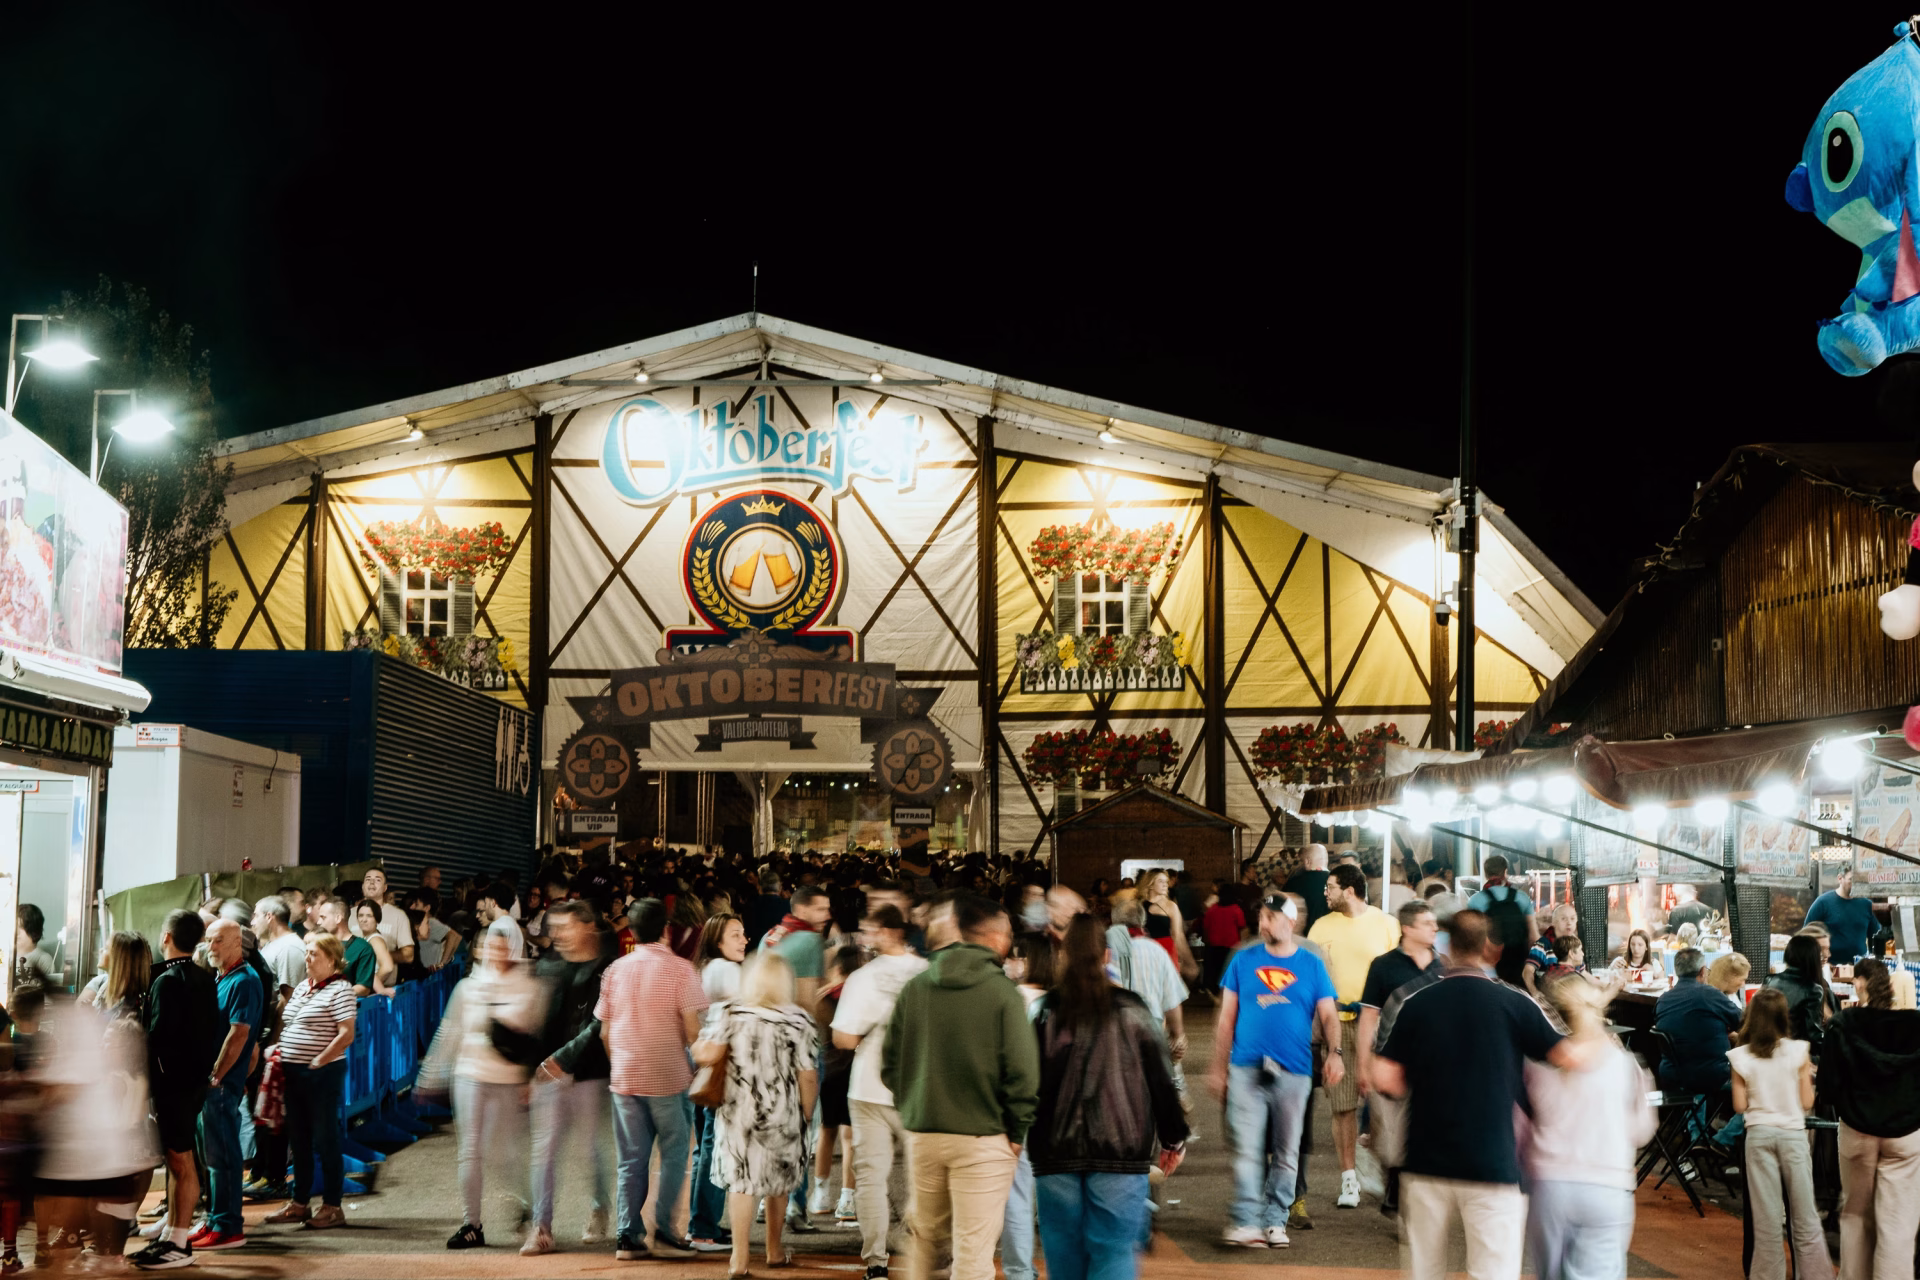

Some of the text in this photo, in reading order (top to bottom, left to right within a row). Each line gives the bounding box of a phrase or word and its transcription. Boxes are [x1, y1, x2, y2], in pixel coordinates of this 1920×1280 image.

[602, 394, 921, 501] Oktoberfest
[616, 667, 892, 717] OKTOBERFEST
[50, 719, 111, 761] ASADAS
[721, 720, 790, 740] VALDESPARTERA
[574, 815, 616, 823] ENTRADA
[895, 812, 931, 820] ENTRADA
[587, 823, 603, 831] VIP
